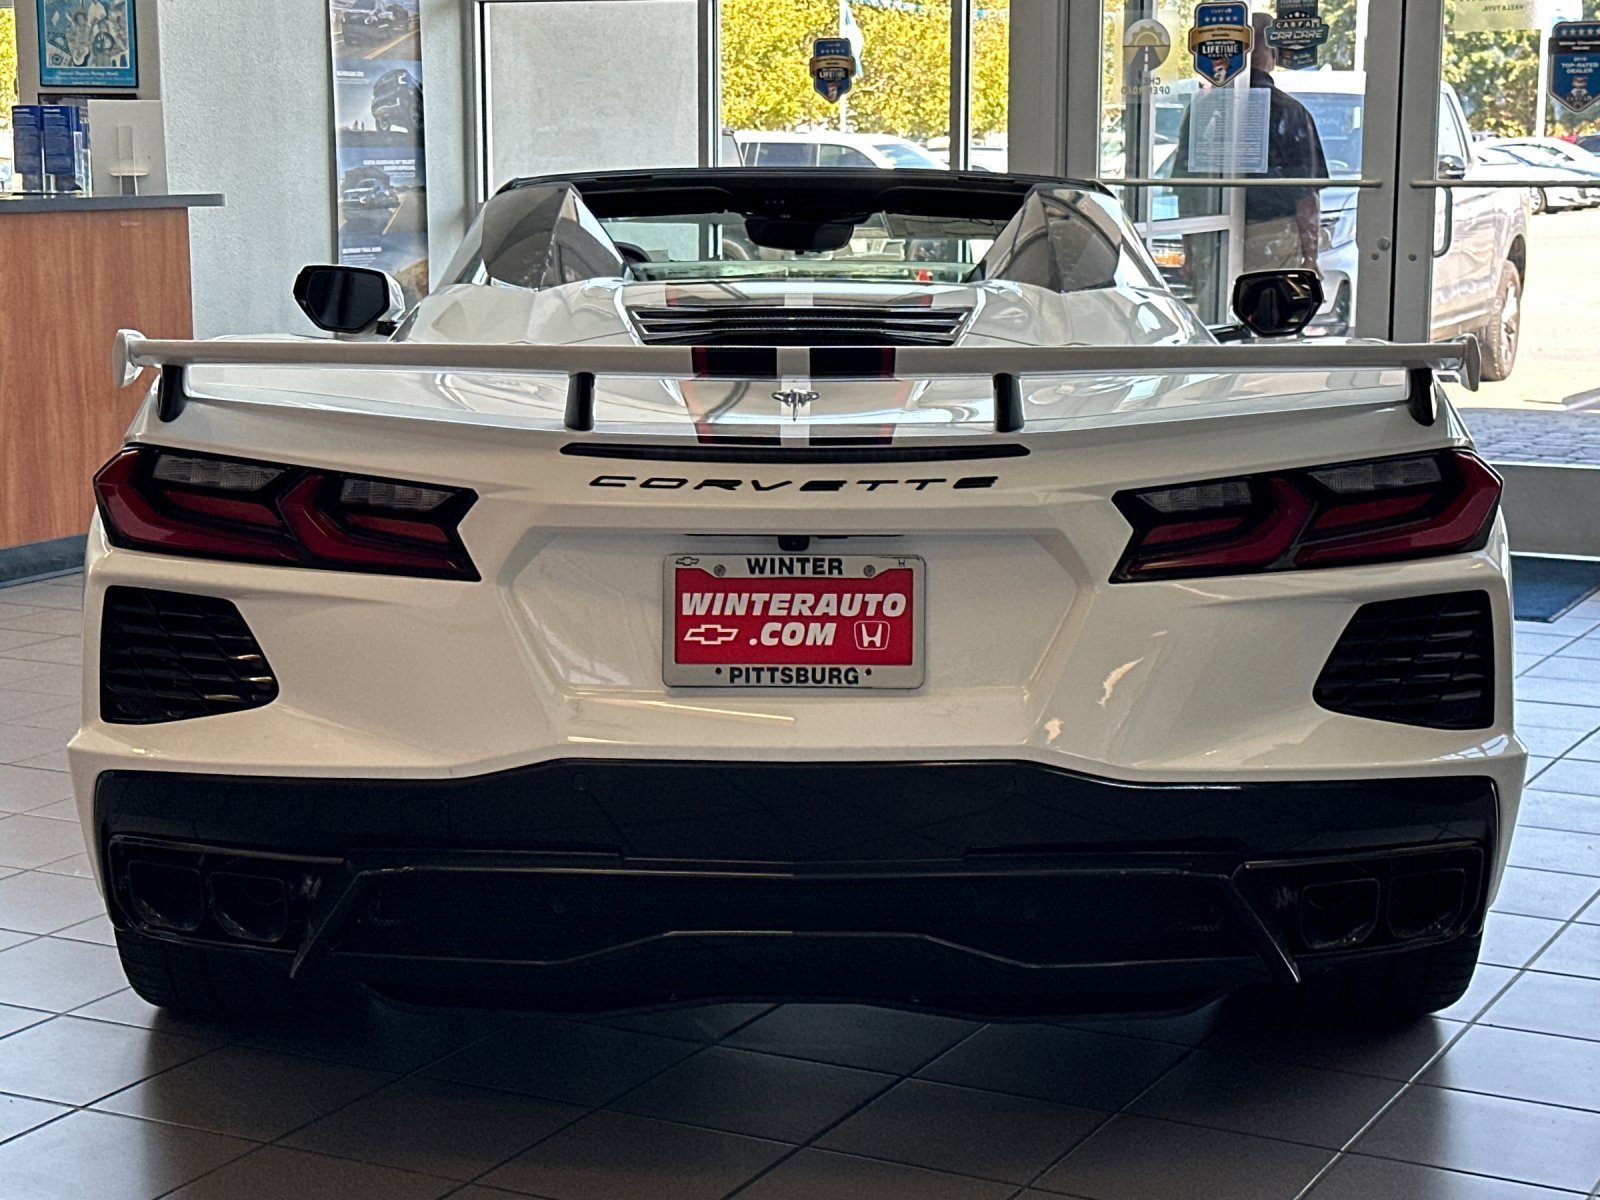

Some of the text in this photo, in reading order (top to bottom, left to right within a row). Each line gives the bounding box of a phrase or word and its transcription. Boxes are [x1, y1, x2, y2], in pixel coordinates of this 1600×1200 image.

[1202, 45, 1239, 54] LIFETIME
[589, 475, 1000, 492] CORVETTE
[747, 557, 843, 576] WINTER
[681, 592, 907, 617] WINTERAUTO
[749, 622, 837, 646] .COM
[729, 667, 860, 685] PITTSBURG
